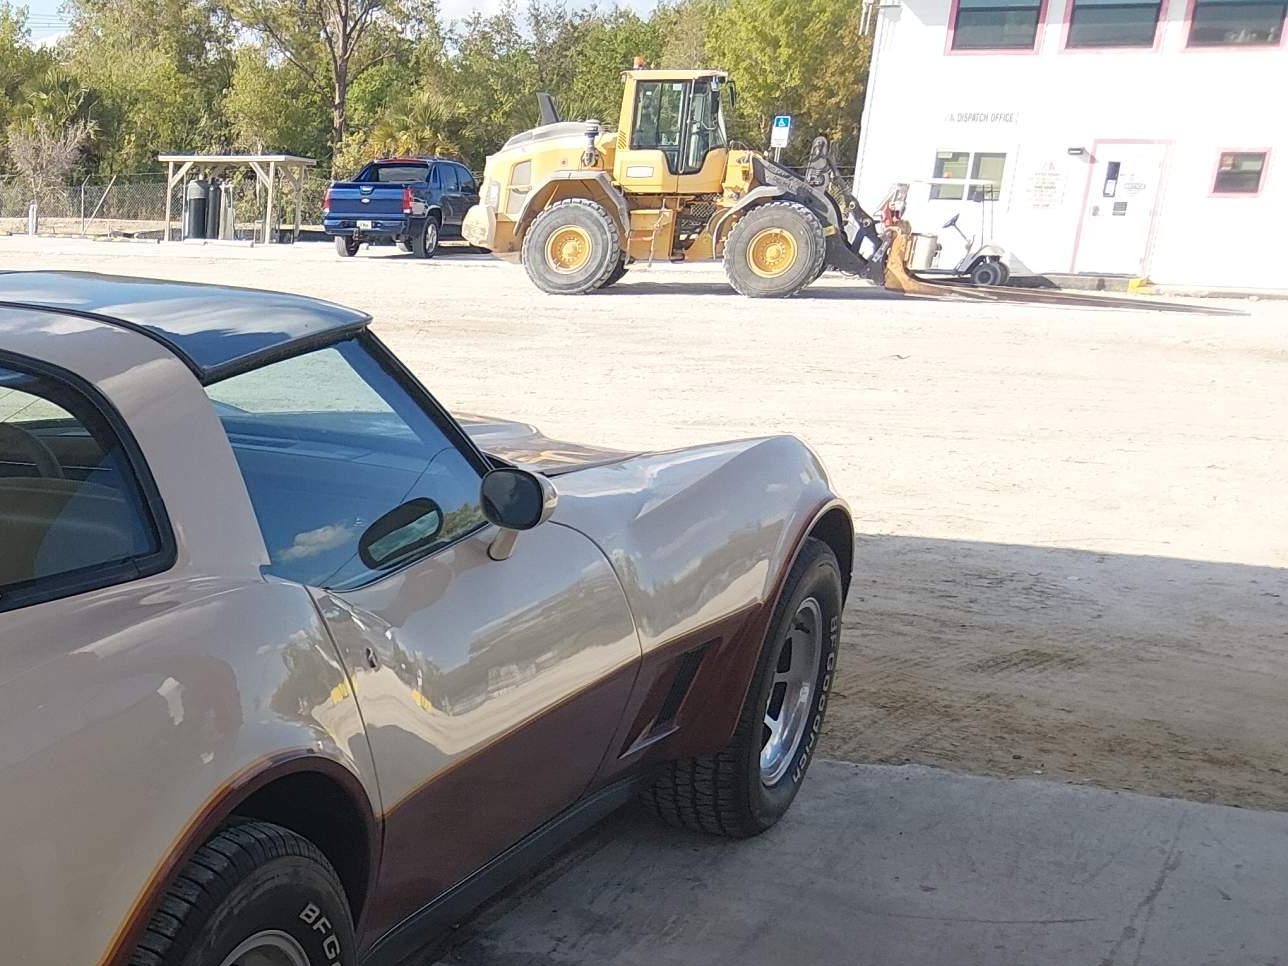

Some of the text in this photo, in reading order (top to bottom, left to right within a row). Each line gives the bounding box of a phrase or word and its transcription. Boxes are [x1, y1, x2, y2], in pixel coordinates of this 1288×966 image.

[957, 112, 989, 122] DISPATCH
[990, 112, 1014, 122] OFFICE
[793, 616, 838, 783] BFGoodrich
